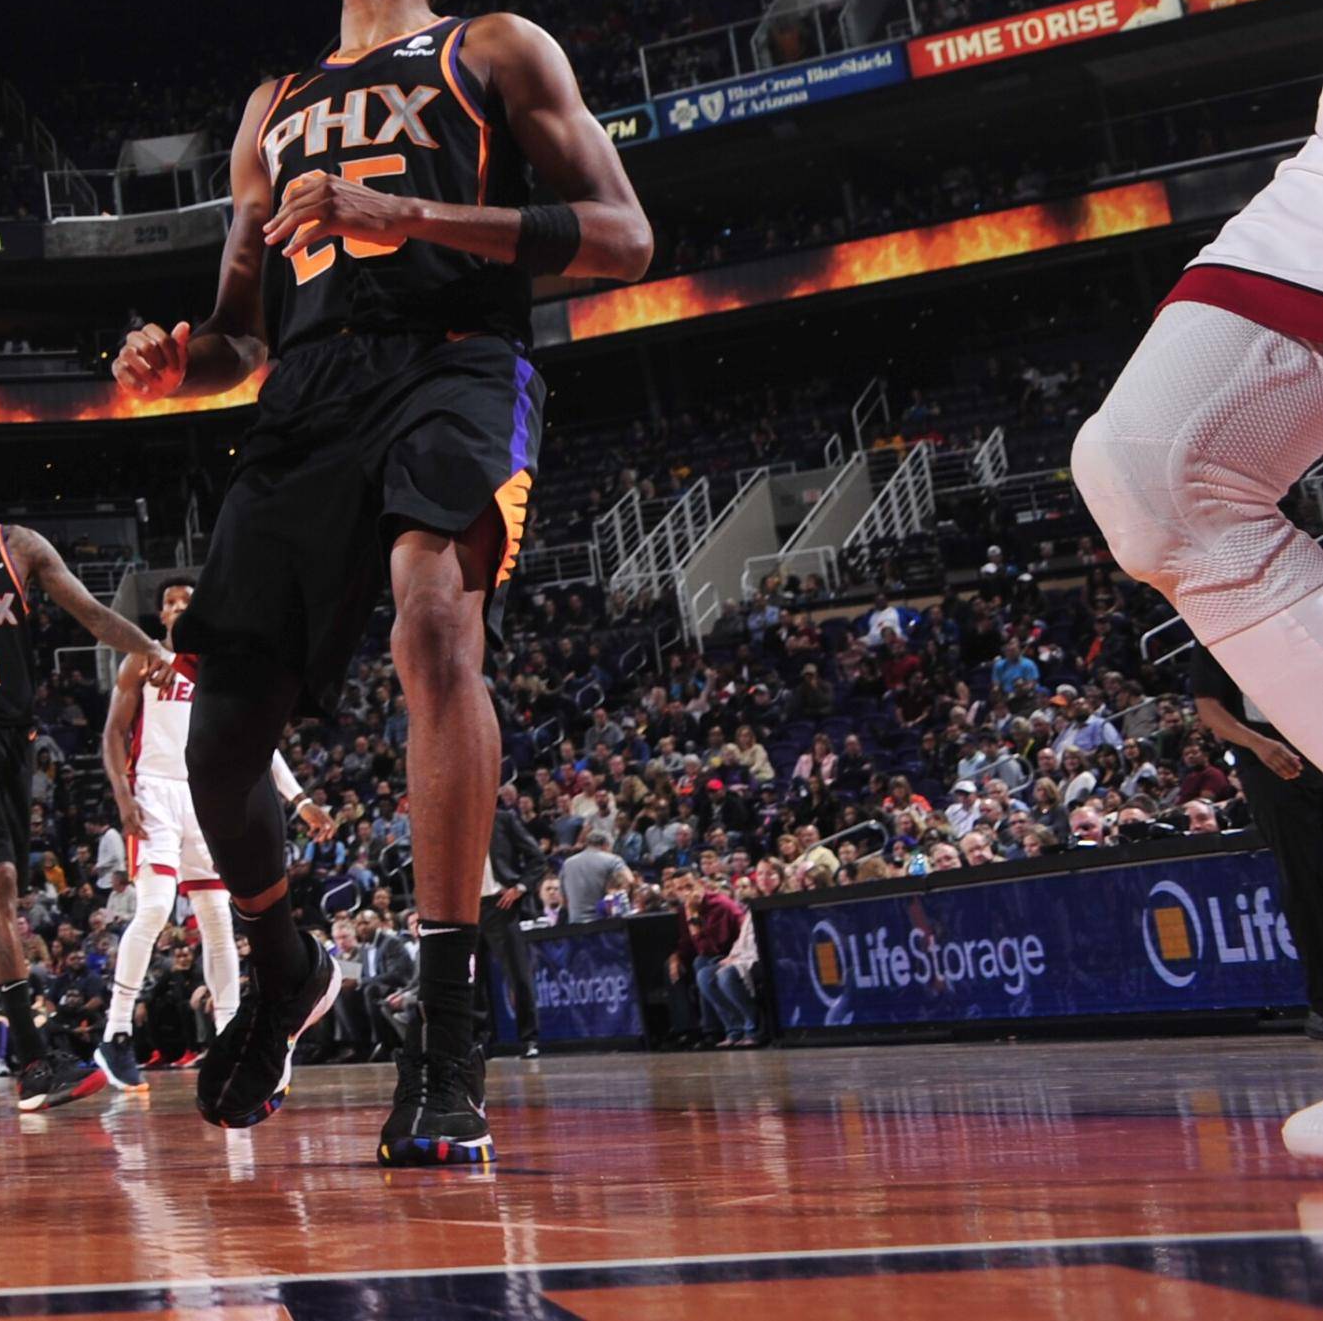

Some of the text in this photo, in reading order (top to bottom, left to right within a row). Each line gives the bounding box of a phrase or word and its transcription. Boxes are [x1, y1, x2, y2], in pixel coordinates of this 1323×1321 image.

[924, 0, 1119, 68] TIME TO RISE
[261, 83, 442, 188] PHX
[728, 88, 809, 118] of Arizona
[535, 967, 629, 1014] ifeStorage
[851, 925, 1045, 996] LifeStorage
